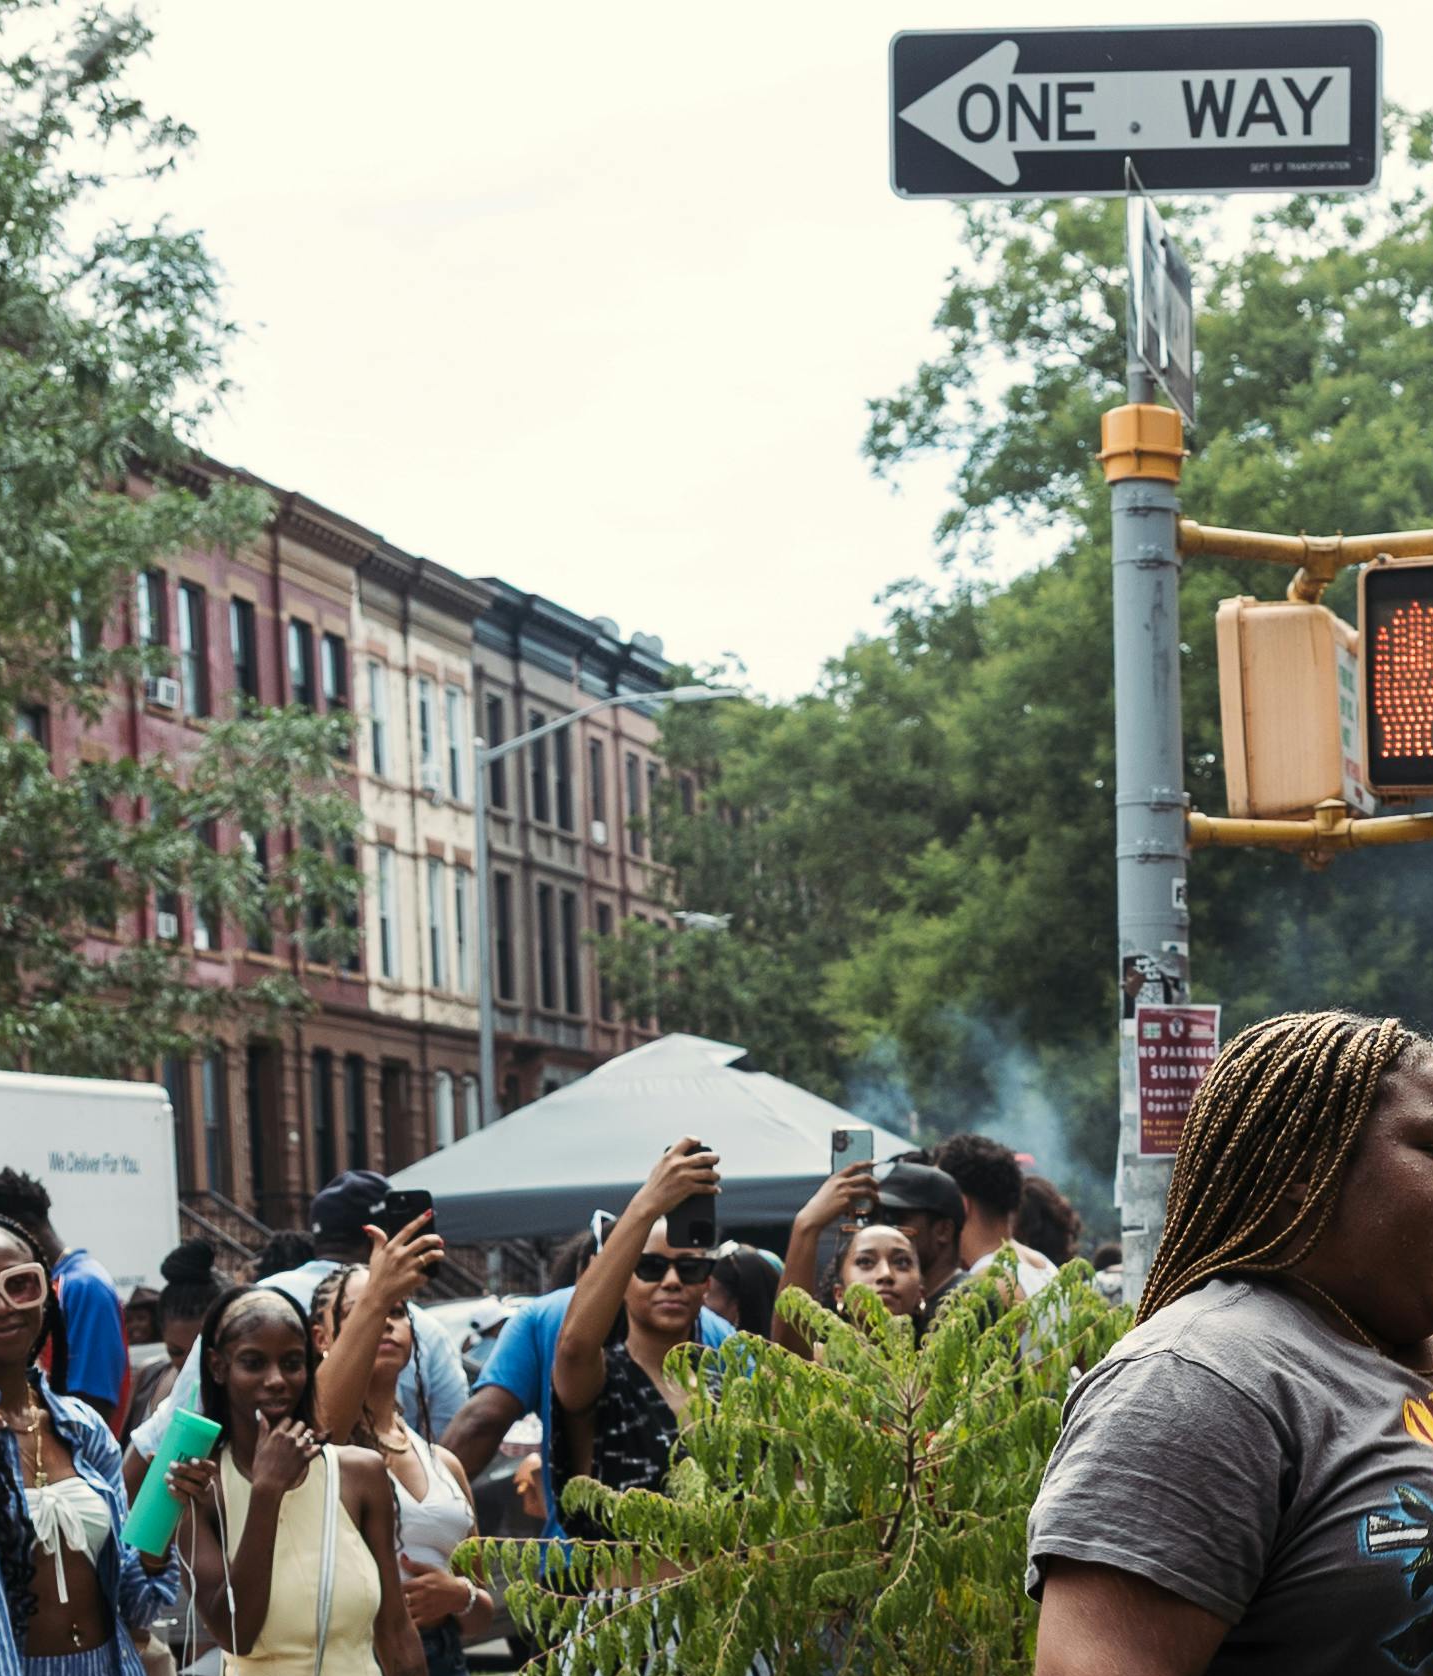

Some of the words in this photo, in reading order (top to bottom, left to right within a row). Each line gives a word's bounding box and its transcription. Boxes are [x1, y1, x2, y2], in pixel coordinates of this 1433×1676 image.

[957, 81, 1096, 144] ONE
[1181, 75, 1334, 139] WAY
[1139, 1045, 1157, 1058] NO
[1160, 1045, 1215, 1059] PARKING
[1150, 1065, 1206, 1079] SUNDAY
[1147, 1101, 1174, 1114] Open
[48, 1150, 65, 1171] We
[66, 1151, 99, 1174] Deliver
[101, 1152, 118, 1174] For
